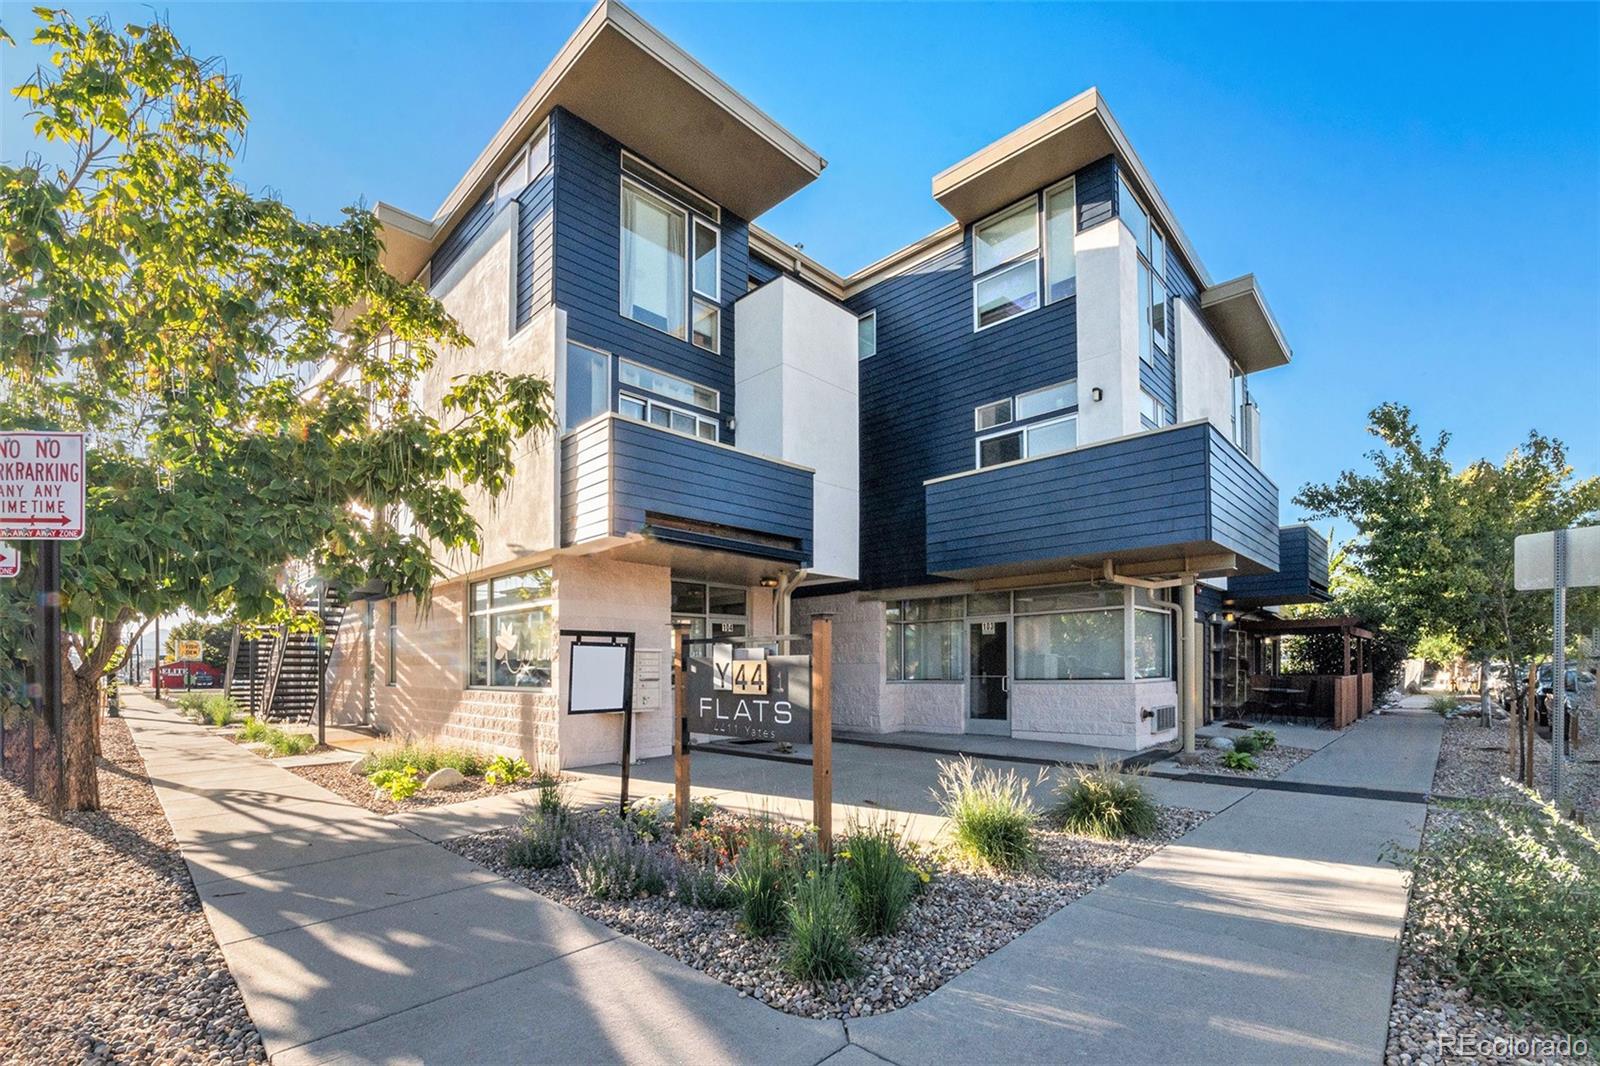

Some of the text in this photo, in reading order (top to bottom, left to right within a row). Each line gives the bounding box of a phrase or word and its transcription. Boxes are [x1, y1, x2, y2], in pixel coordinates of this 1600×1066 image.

[0, 440, 60, 458] NO NO
[34, 484, 62, 497] ANY
[32, 500, 65, 513] TIME
[59, 529, 78, 538] ZONE
[700, 697, 792, 724] FLATS
[744, 724, 776, 739] Yates
